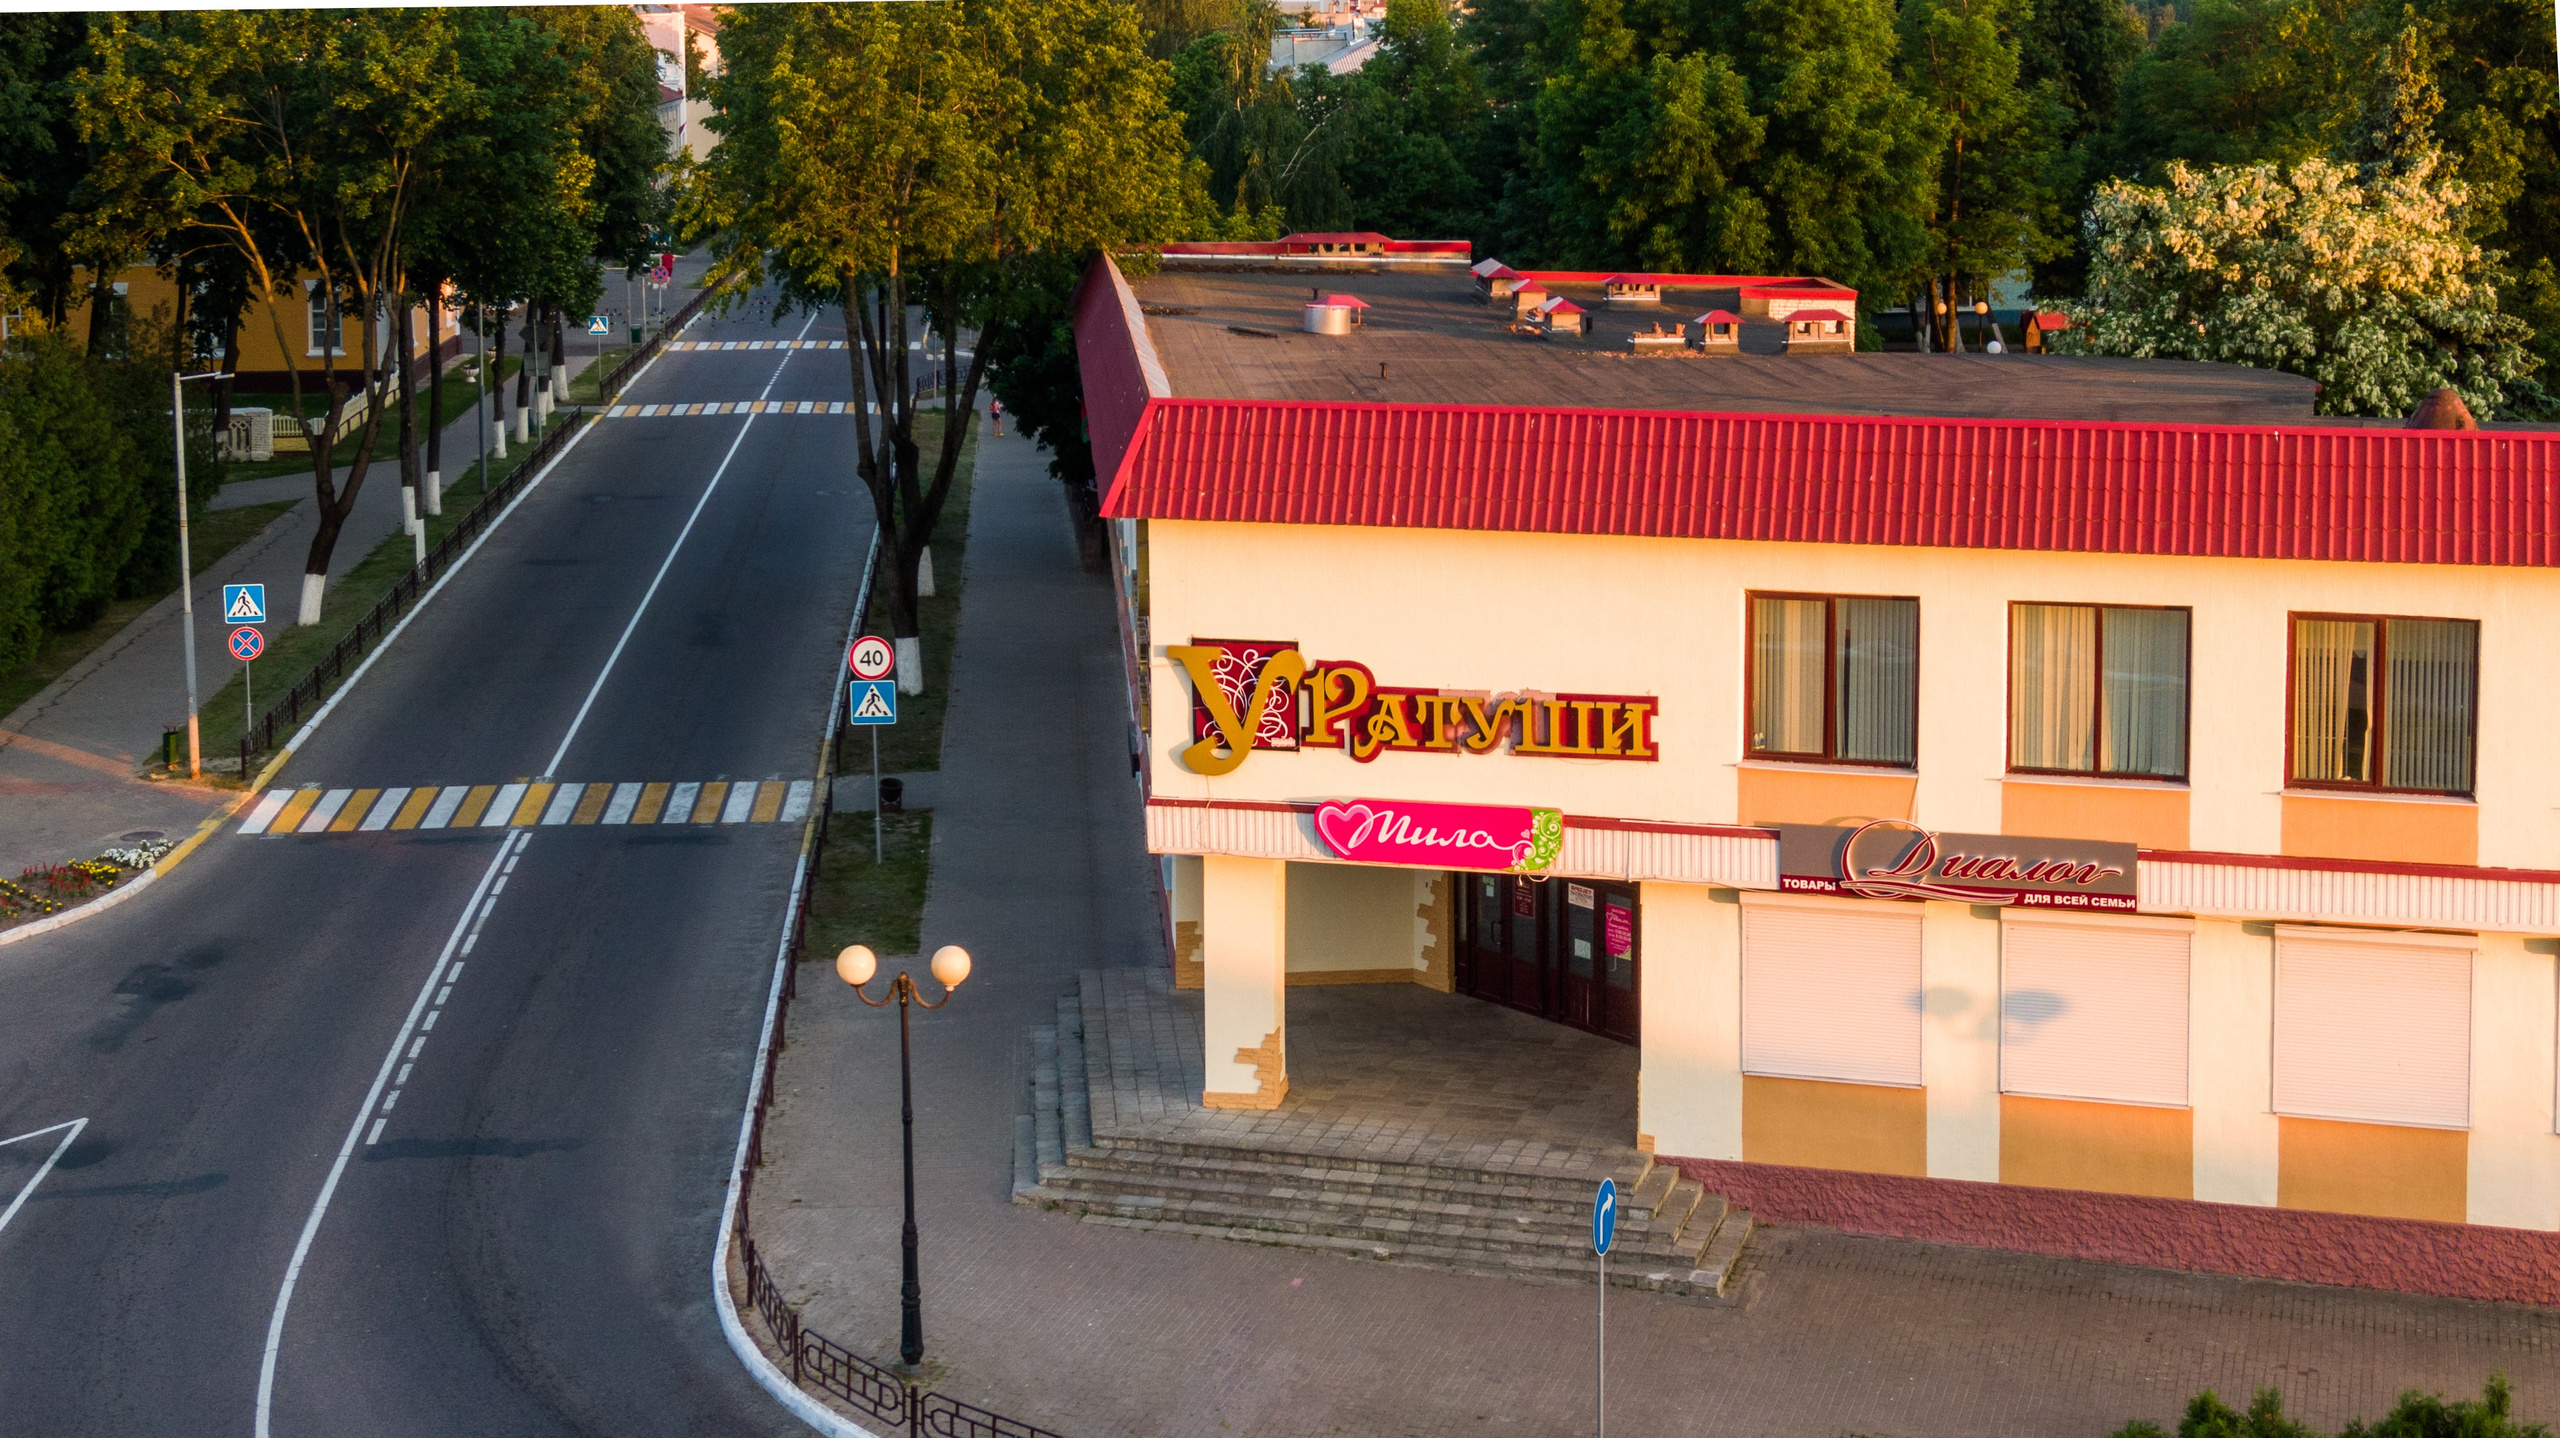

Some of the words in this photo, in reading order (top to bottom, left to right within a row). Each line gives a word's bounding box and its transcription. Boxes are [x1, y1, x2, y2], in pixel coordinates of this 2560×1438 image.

[859, 650, 883, 666] 40
[1167, 645, 1306, 776] У
[1347, 810, 1500, 850] Мила
[1841, 819, 2122, 899] Диалог
[2024, 893, 2051, 904] ДЛЯ
[2054, 895, 2088, 906] ВСЕЙ
[2091, 897, 2136, 909] СЕМЬИ
